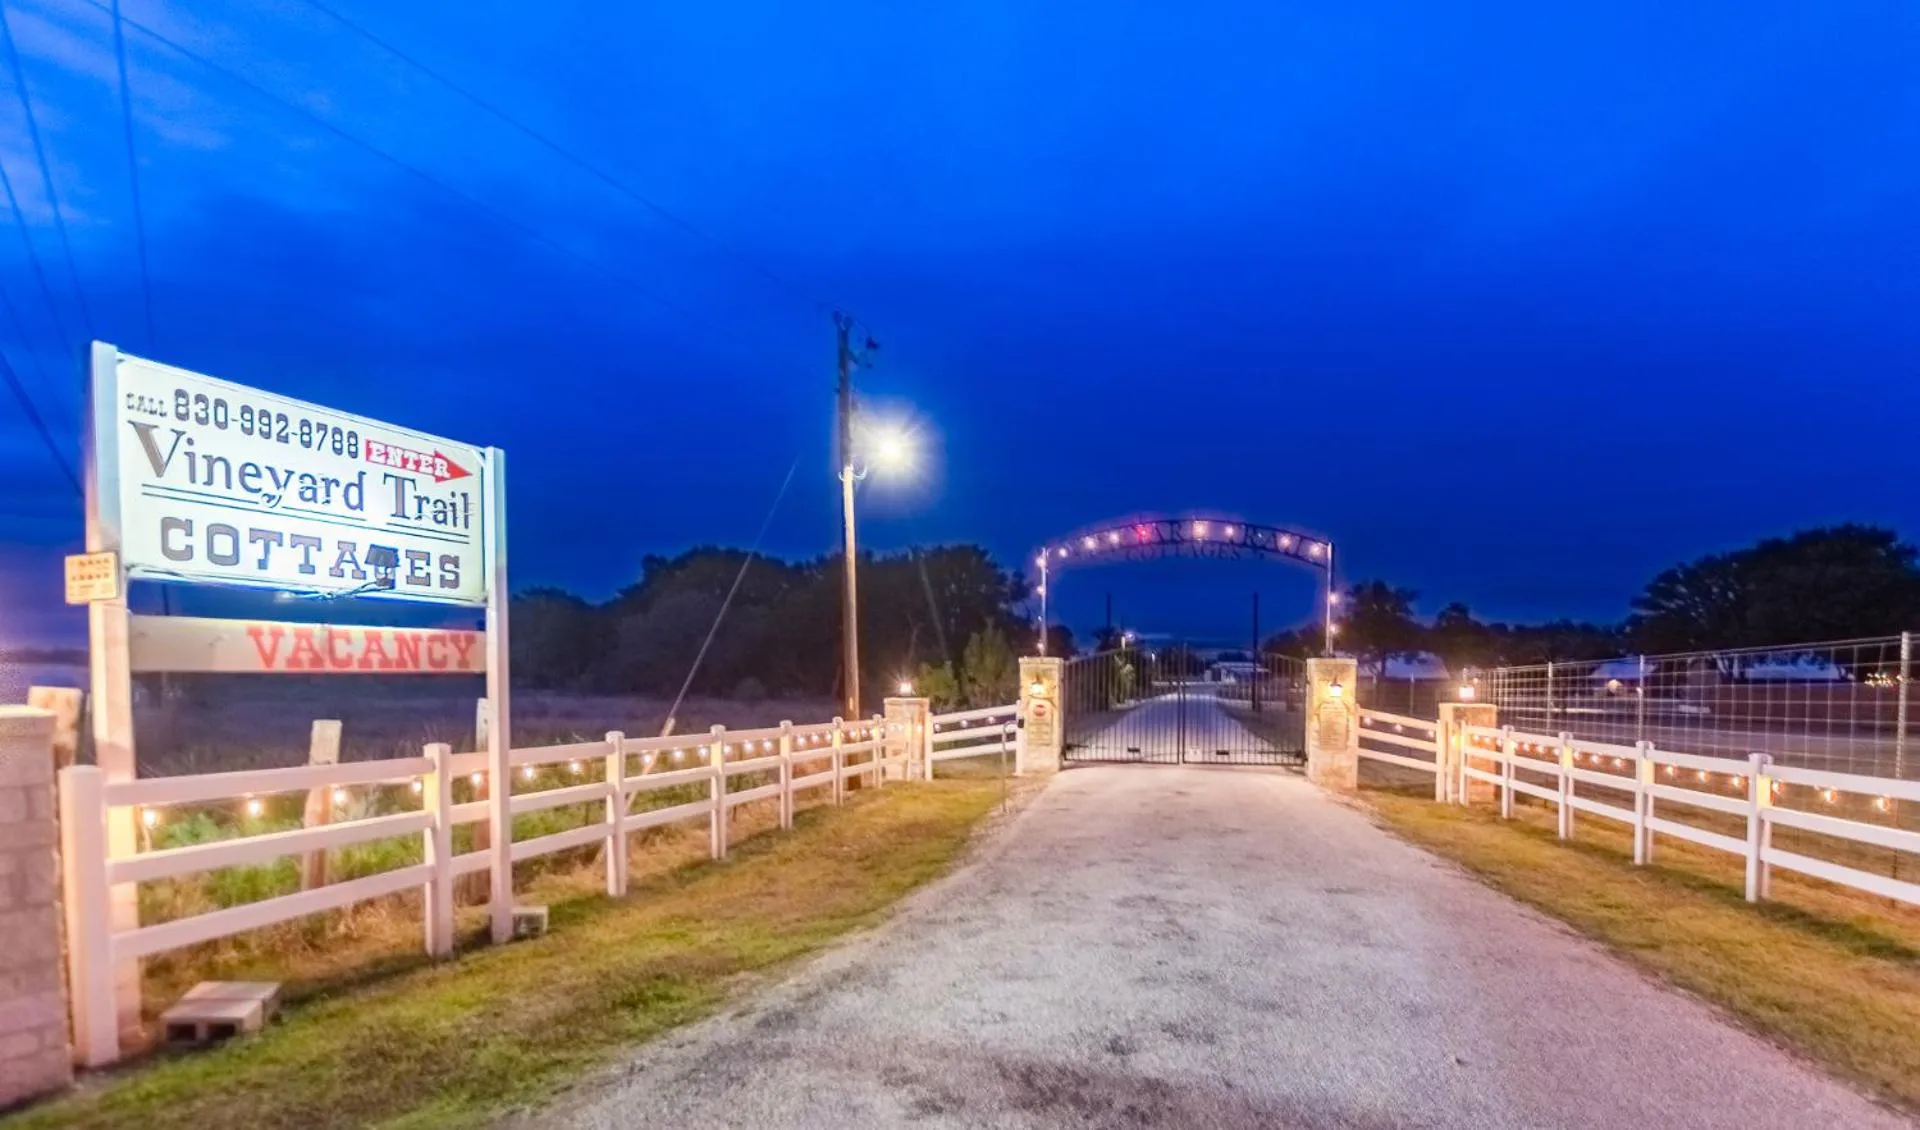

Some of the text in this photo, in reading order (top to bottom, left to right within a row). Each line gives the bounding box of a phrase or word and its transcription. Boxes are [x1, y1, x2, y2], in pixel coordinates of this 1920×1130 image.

[126, 388, 359, 459] CALL 830-992-8788
[127, 420, 469, 529] Vineyard Trail
[369, 440, 451, 478] ENTER
[247, 623, 477, 670] VACANCY
